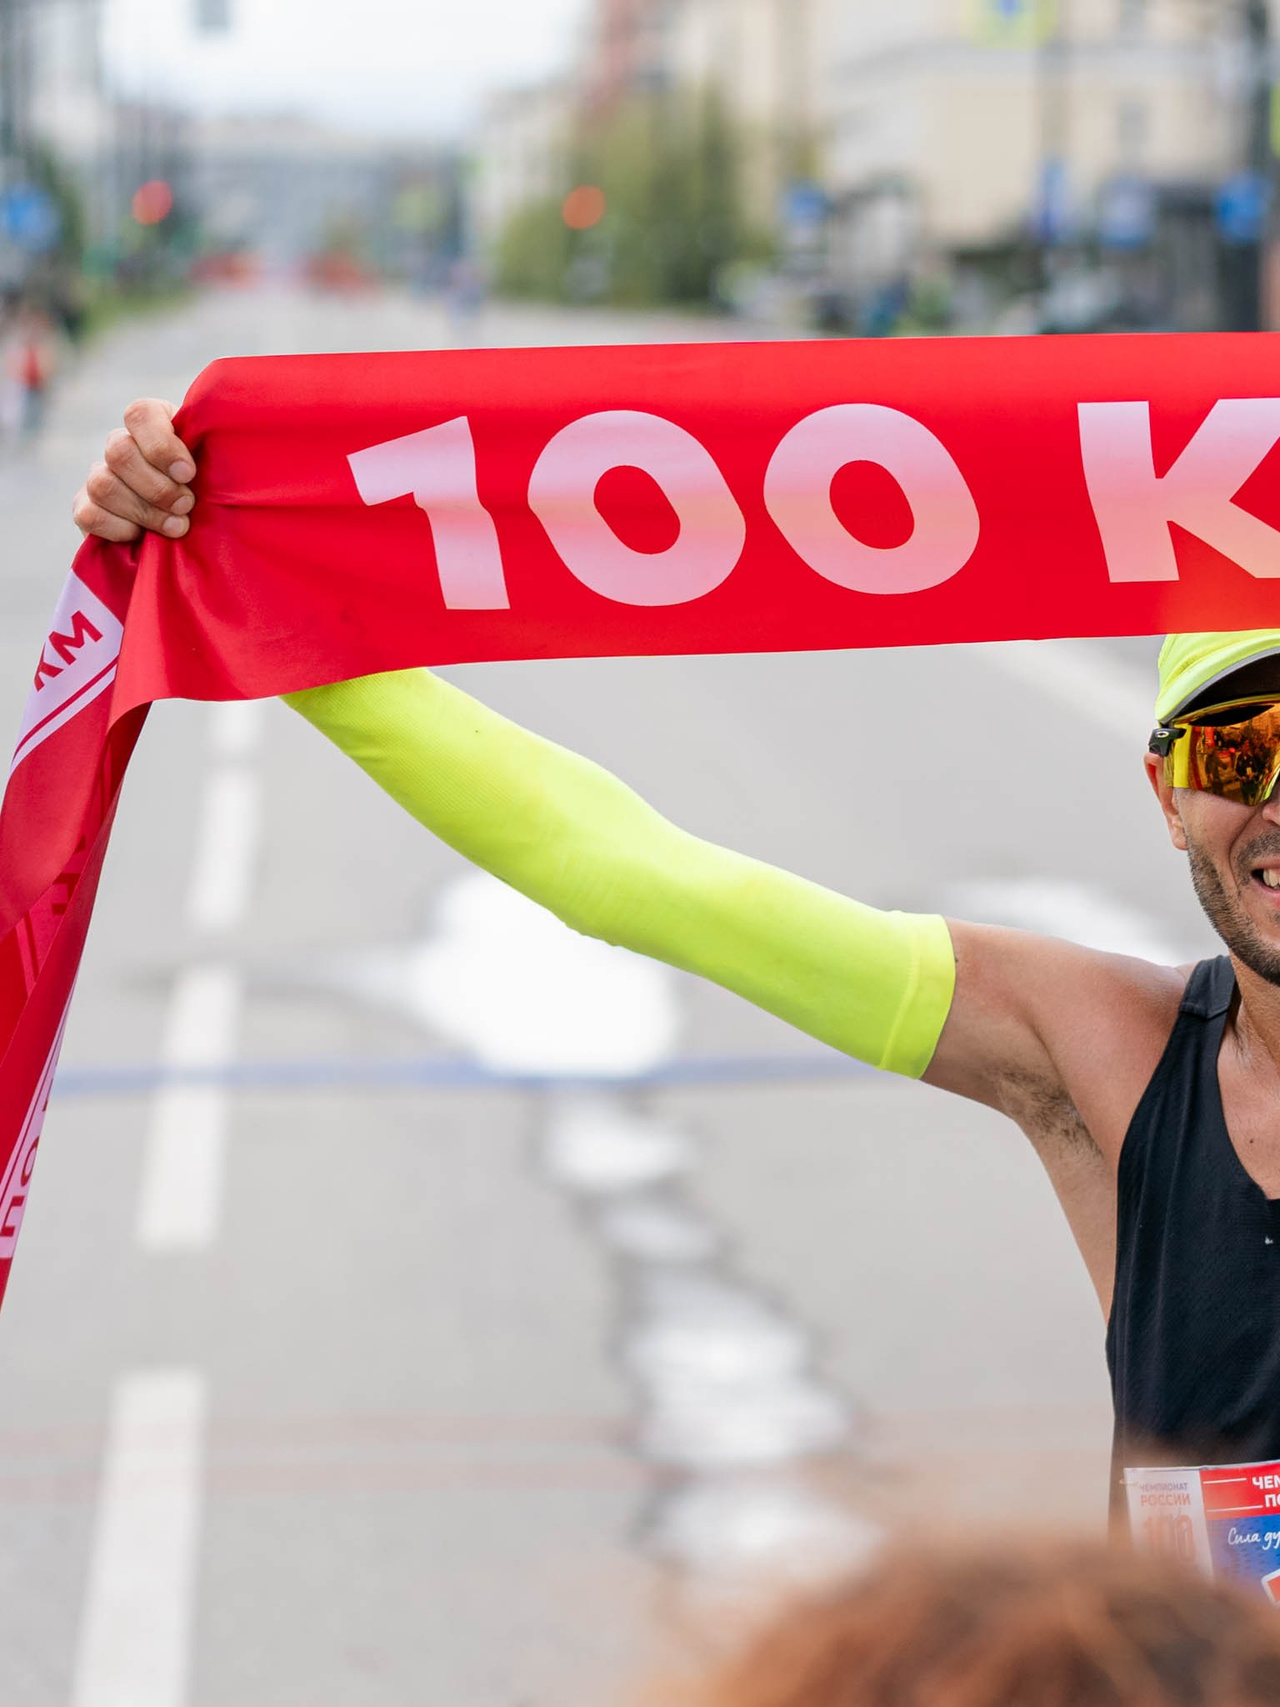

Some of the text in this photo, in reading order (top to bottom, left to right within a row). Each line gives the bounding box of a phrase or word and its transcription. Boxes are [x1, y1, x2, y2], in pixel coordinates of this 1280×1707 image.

[346, 402, 981, 611] 100
[1139, 1493, 1192, 1507] РОССИИ
[1228, 1527, 1261, 1545] Сила
